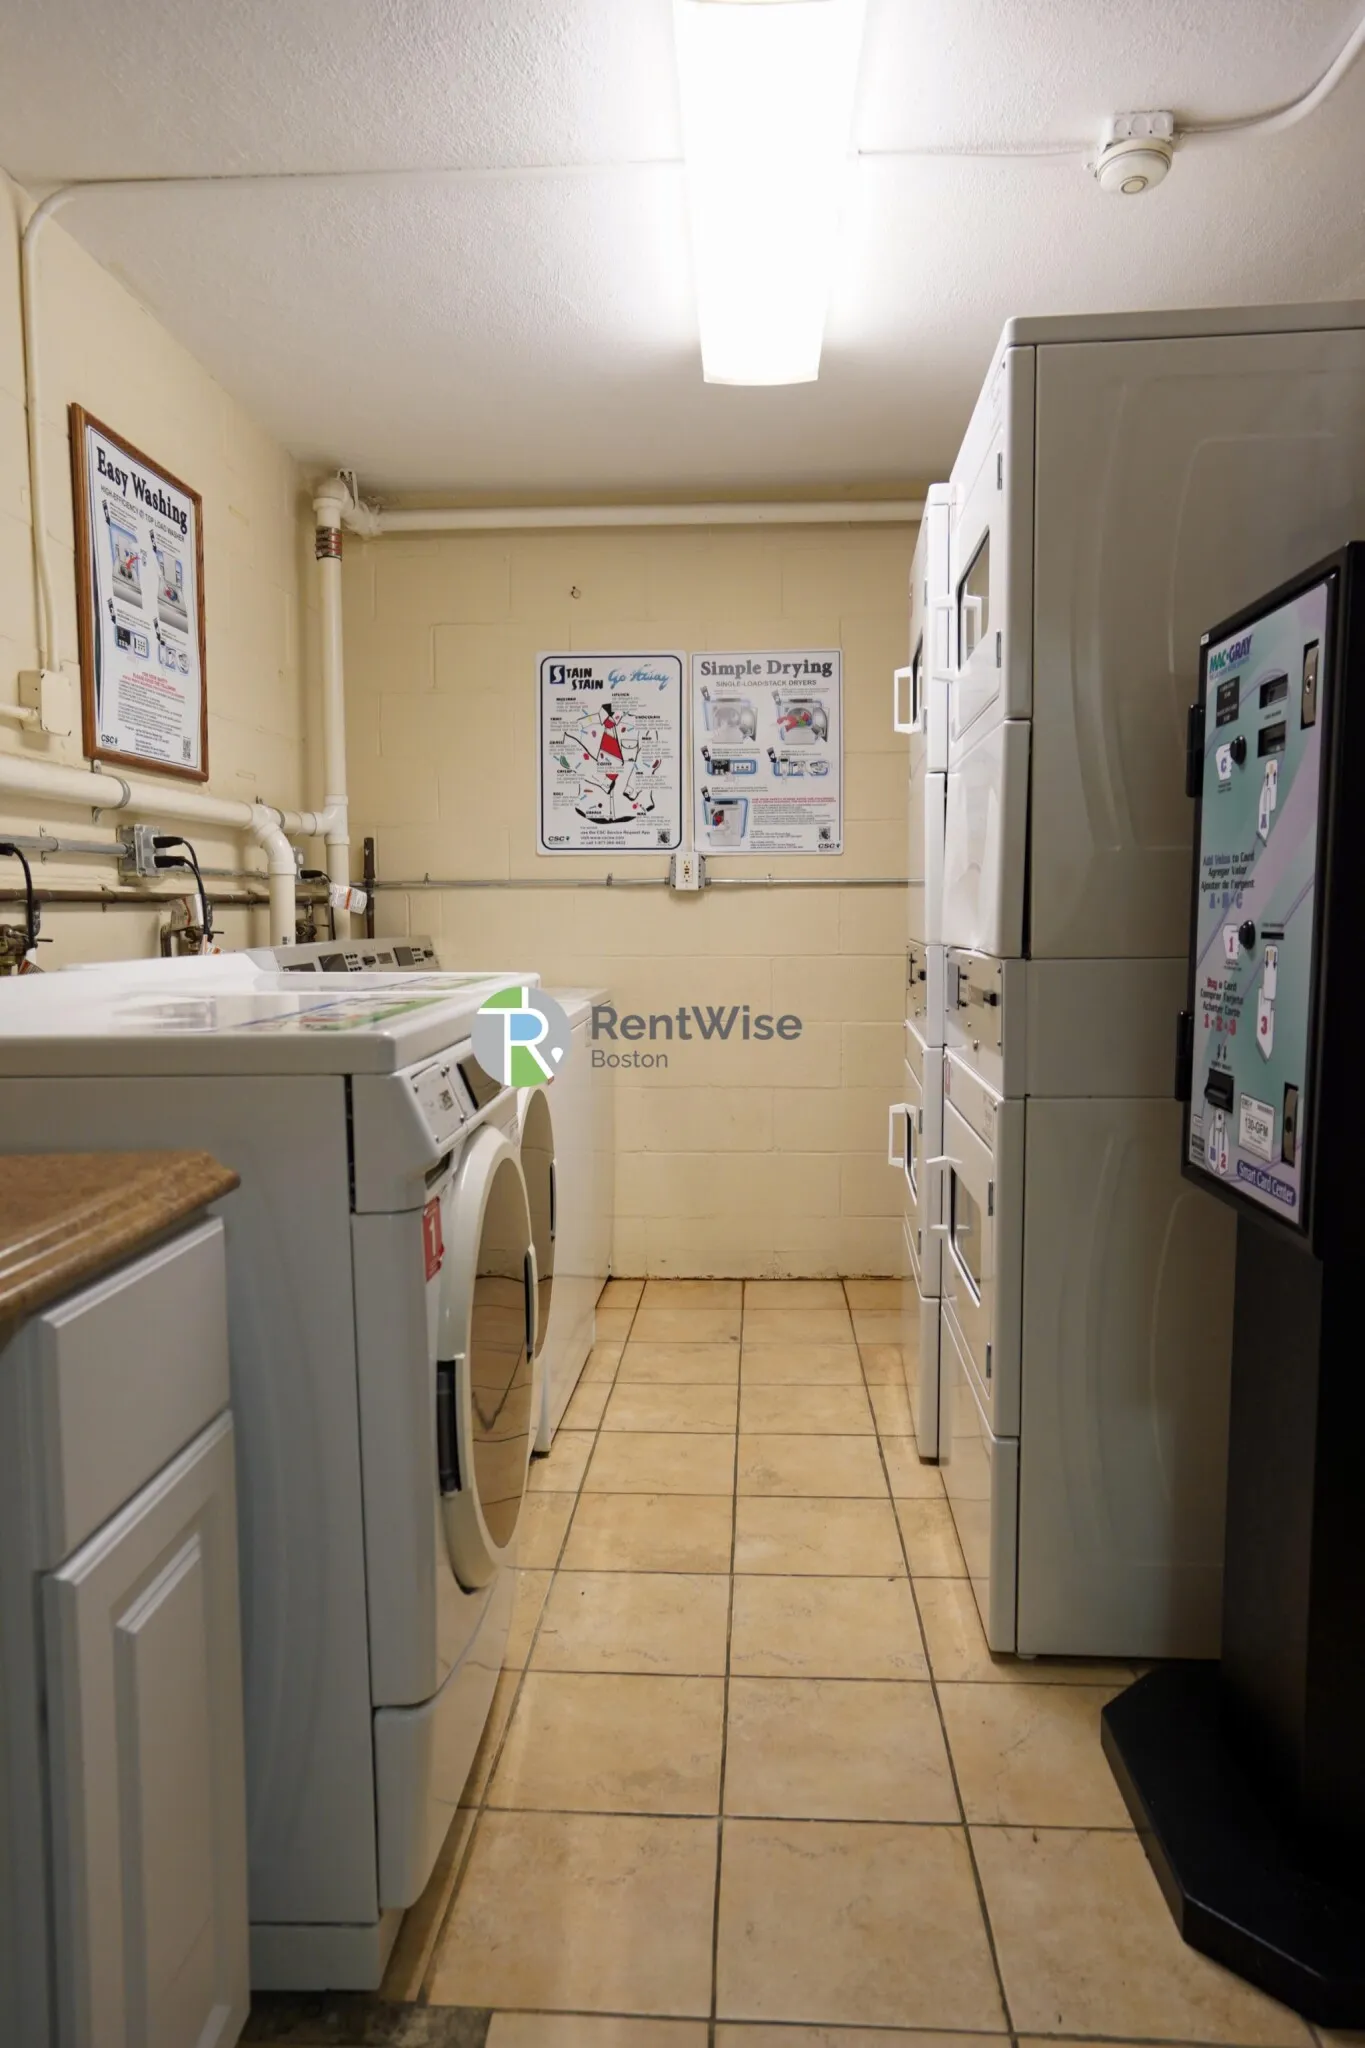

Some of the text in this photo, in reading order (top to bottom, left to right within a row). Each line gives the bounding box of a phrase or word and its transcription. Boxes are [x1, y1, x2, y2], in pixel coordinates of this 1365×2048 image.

[97, 446, 128, 497] Easy
[131, 472, 187, 534] Washing
[701, 659, 832, 679] Simple Drying
[572, 679, 603, 690] STAIN
[608, 667, 626, 690] Go
[630, 665, 669, 691] Away
[101, 734, 114, 744] CSC
[1221, 758, 1227, 773] C
[1232, 854, 1239, 863] to
[1240, 851, 1254, 862] Card
[1222, 880, 1229, 889] de
[1229, 936, 1233, 952] 1
[1224, 980, 1237, 991] Card
[1261, 1016, 1268, 1035] 3
[1221, 1153, 1226, 1169] 2
[1240, 1162, 1294, 1204] Smart Card Center
[429, 1216, 436, 1257] 1
